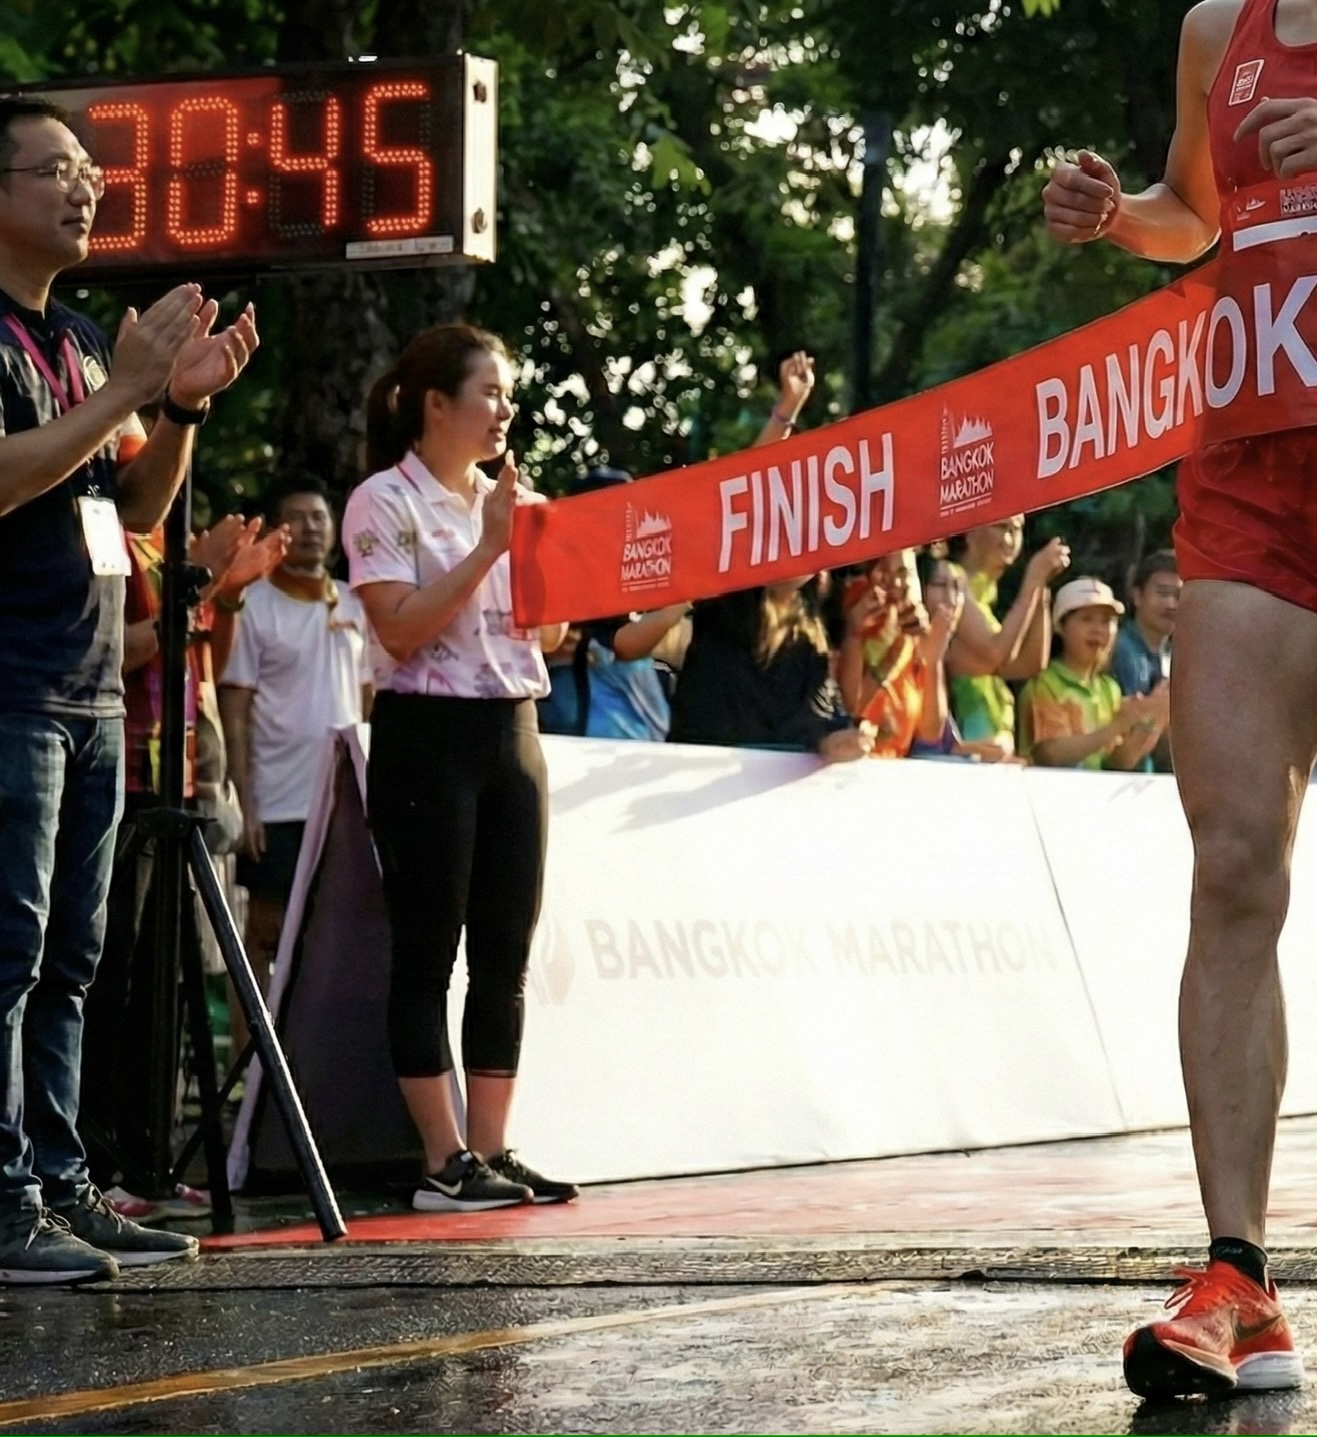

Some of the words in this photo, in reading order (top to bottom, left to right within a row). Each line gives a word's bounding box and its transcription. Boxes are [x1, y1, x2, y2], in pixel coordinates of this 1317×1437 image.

[86, 82, 433, 249] 30:45
[940, 468, 994, 505] MARATHON
[941, 441, 994, 480] BANGKOK
[718, 432, 895, 573] FINISH
[584, 918, 814, 979] BANGKOK
[825, 919, 1058, 976] MARATHON
